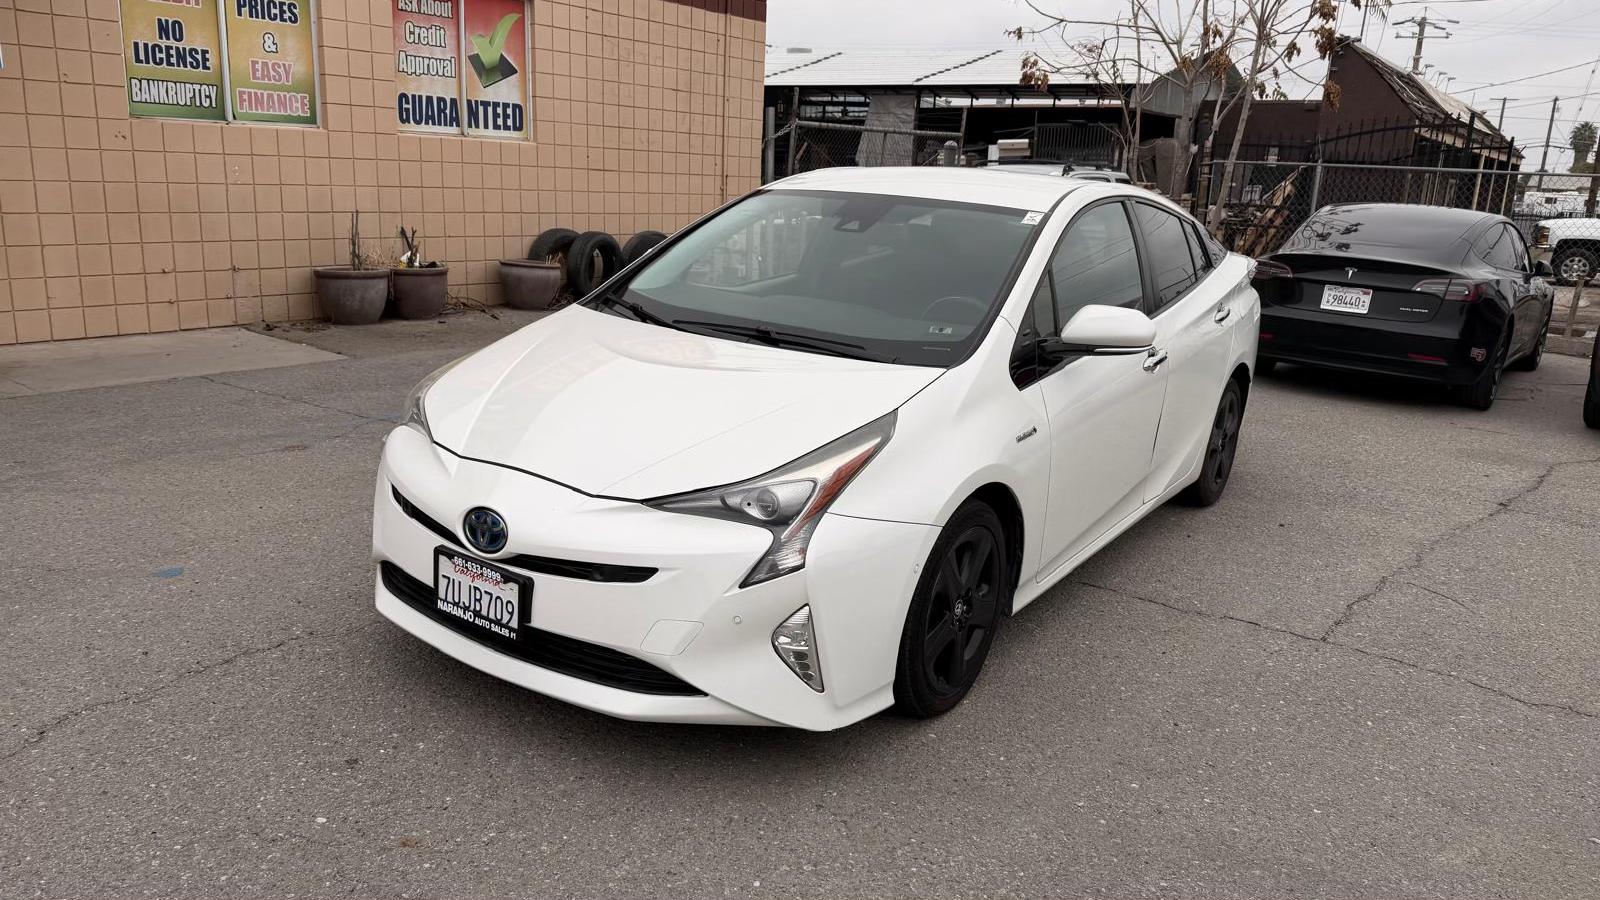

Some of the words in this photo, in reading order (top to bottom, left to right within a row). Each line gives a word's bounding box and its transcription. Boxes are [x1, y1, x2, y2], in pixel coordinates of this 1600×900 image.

[236, 0, 299, 24] PRICES
[156, 17, 184, 42] NO
[262, 32, 278, 53] &
[405, 21, 446, 48] Credit
[132, 41, 211, 71] LICENSE
[398, 51, 456, 78] Approval
[250, 59, 293, 84] EASY
[130, 77, 217, 108] BANKRUPTCY
[237, 88, 310, 115] FINANCE
[397, 93, 524, 132] GUARANTEED
[441, 574, 515, 626] 7UJB709
[437, 599, 474, 622] NARANJO
[474, 617, 490, 629] AUTO
[490, 622, 509, 637] SALES
